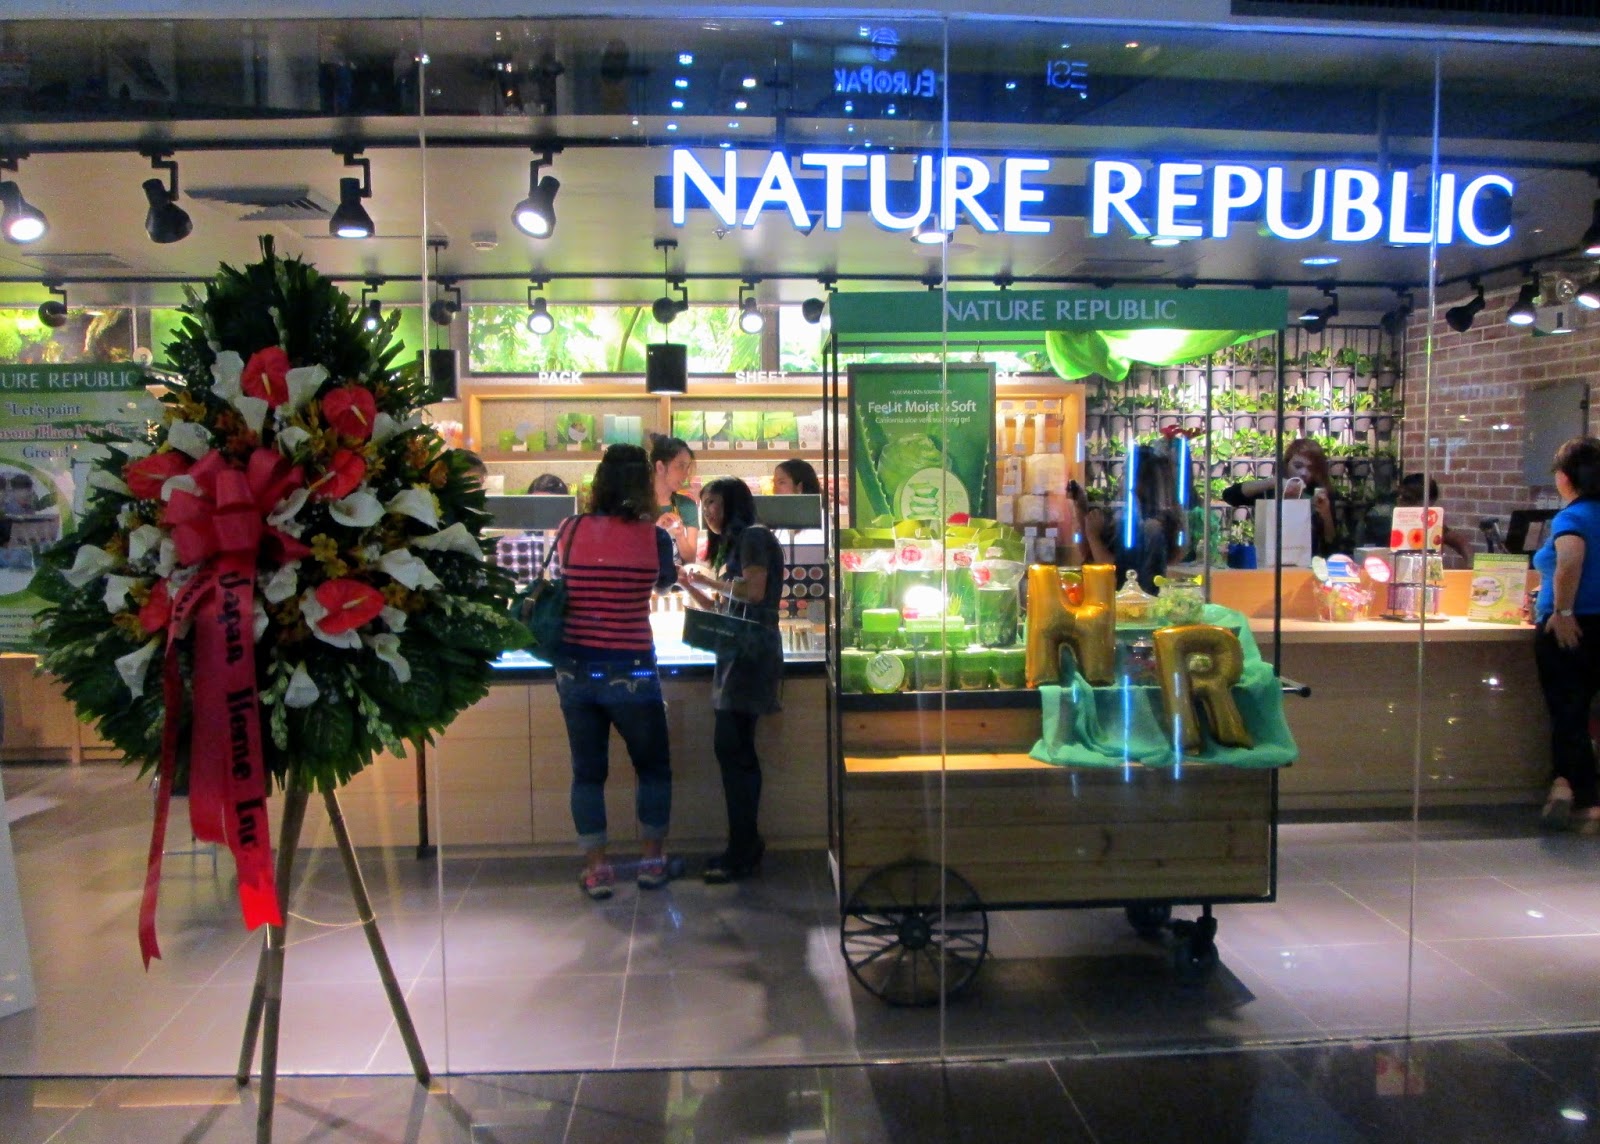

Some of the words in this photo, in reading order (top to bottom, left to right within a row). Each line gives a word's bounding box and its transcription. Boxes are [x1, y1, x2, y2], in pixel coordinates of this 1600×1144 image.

[672, 148, 1052, 234] NATURE
[1091, 160, 1515, 246] REPUBLIC
[944, 300, 1046, 321] NATURE
[1056, 299, 1177, 320] REPUBLIC
[49, 370, 136, 388] REPUBLIC
[538, 372, 584, 384] PACK
[735, 371, 788, 385] SHEET
[47, 403, 81, 418] paint
[868, 401, 892, 413] Feel
[894, 401, 903, 413] it
[905, 400, 940, 413] Moist
[951, 400, 977, 413] Soft
[218, 571, 251, 667] Japan
[1153, 624, 1253, 756] R
[226, 687, 255, 781] Home
